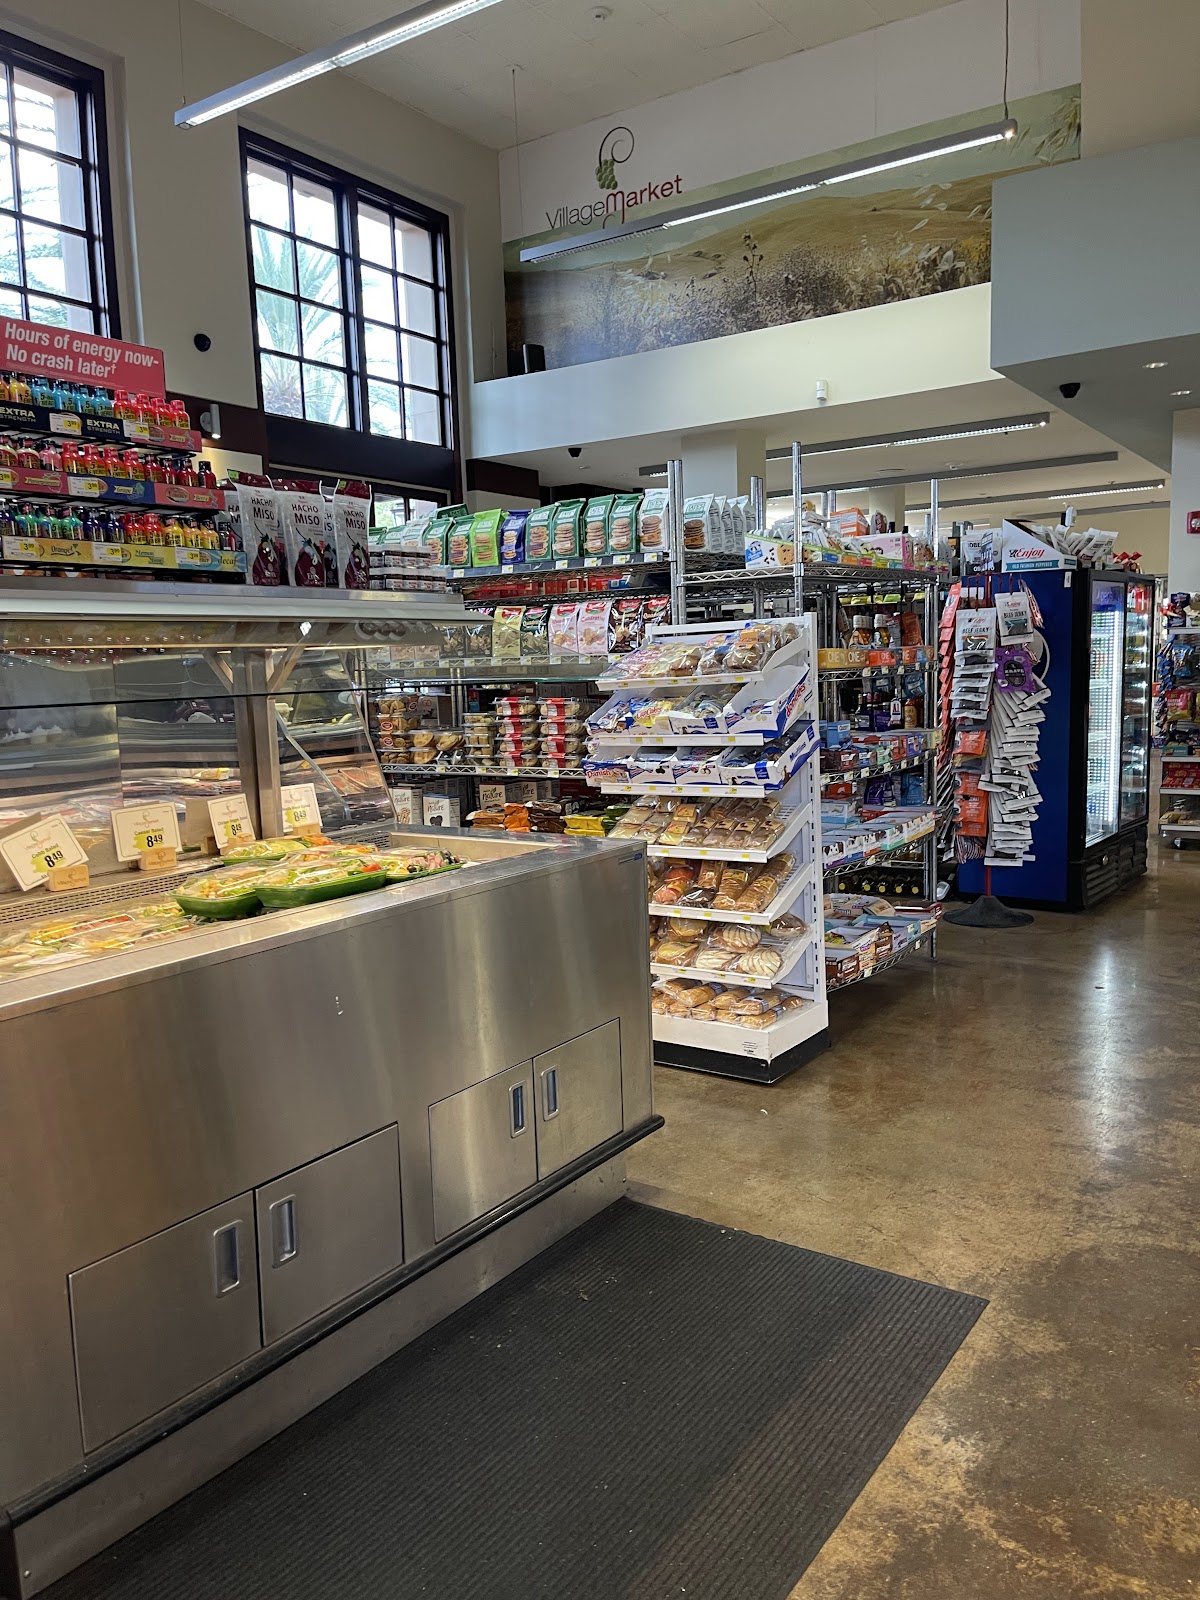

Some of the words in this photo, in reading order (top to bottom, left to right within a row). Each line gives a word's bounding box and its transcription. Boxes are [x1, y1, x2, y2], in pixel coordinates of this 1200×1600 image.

[5, 322, 50, 346] Hours
[54, 335, 70, 350] of
[72, 339, 122, 363] energy
[6, 344, 27, 363] No
[31, 352, 73, 372] crash
[86, 419, 120, 431] EXTRA
[251, 496, 273, 508] HACHO
[292, 503, 319, 513] HACHO
[253, 507, 275, 520] MISO
[343, 508, 364, 518] HACHO
[294, 513, 320, 526] MISO
[346, 518, 366, 530] MISO
[1016, 547, 1045, 559] Enjoy
[586, 768, 612, 779] Danish
